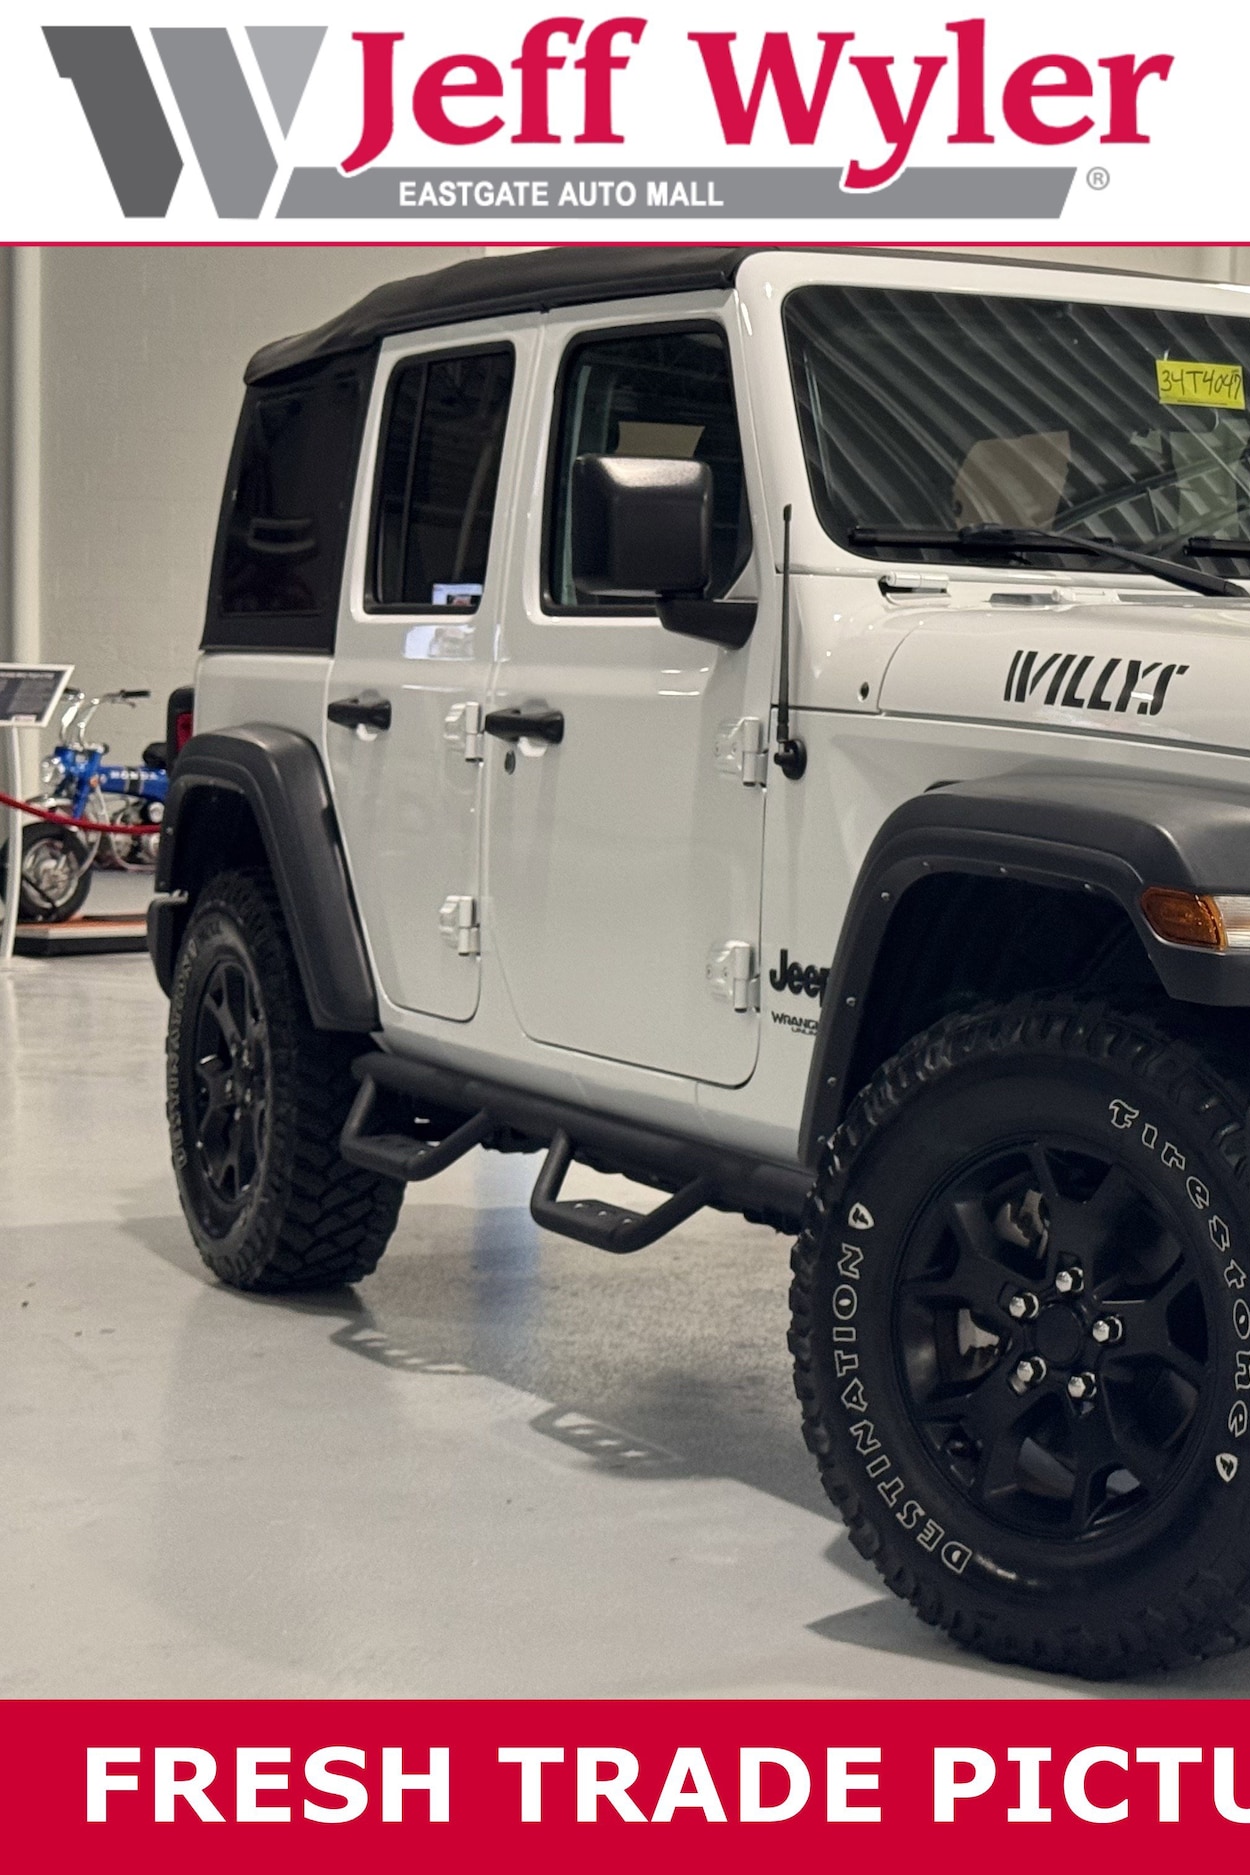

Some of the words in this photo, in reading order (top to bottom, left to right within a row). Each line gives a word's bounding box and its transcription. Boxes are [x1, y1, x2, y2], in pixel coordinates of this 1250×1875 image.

[1003, 649, 1190, 716] WILLYS
[771, 1010, 819, 1030] WRANG
[832, 1242, 973, 1575] DESTINATION
